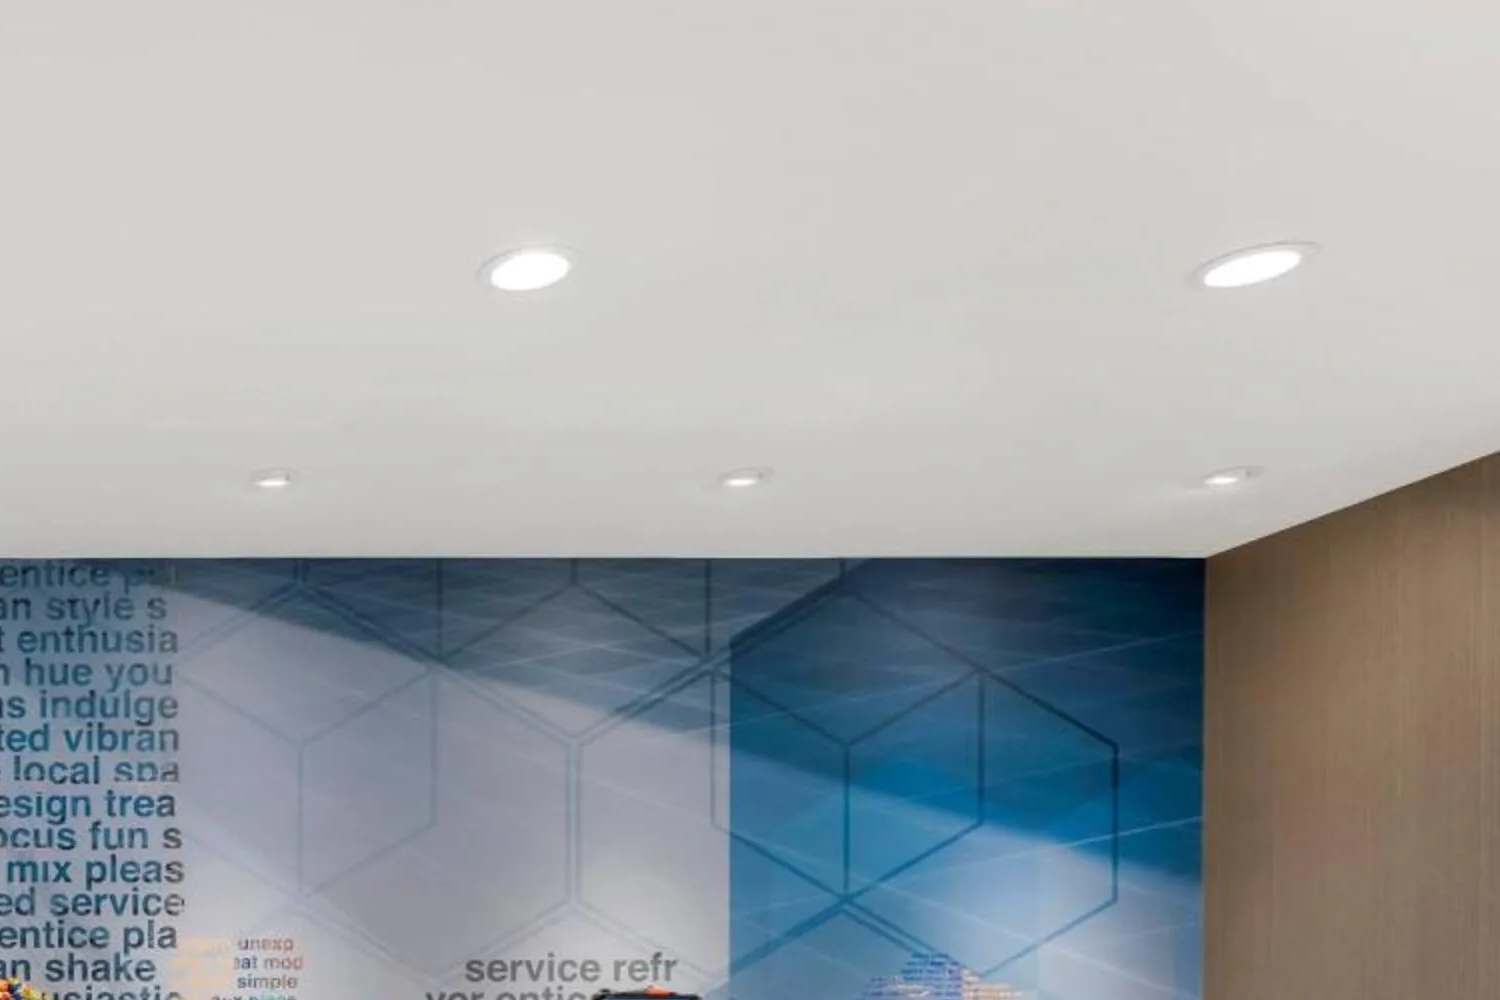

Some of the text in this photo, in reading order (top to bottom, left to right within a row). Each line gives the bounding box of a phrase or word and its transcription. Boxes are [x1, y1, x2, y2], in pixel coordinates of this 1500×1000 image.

[46, 592, 134, 626] style
[147, 597, 167, 620] s
[17, 625, 178, 653] enthusia
[25, 657, 172, 692] hue you
[40, 690, 178, 726] indulge
[63, 722, 180, 751] vibran
[13, 756, 99, 785] local
[104, 790, 176, 817] trea
[89, 821, 148, 850] fun
[162, 828, 183, 850] s
[7, 858, 72, 883] mix
[86, 855, 184, 890] pleas
[50, 887, 184, 916] service
[123, 921, 176, 954] pla
[45, 953, 156, 981] shake
[237, 973, 297, 990] simple
[465, 952, 679, 983] service refr
